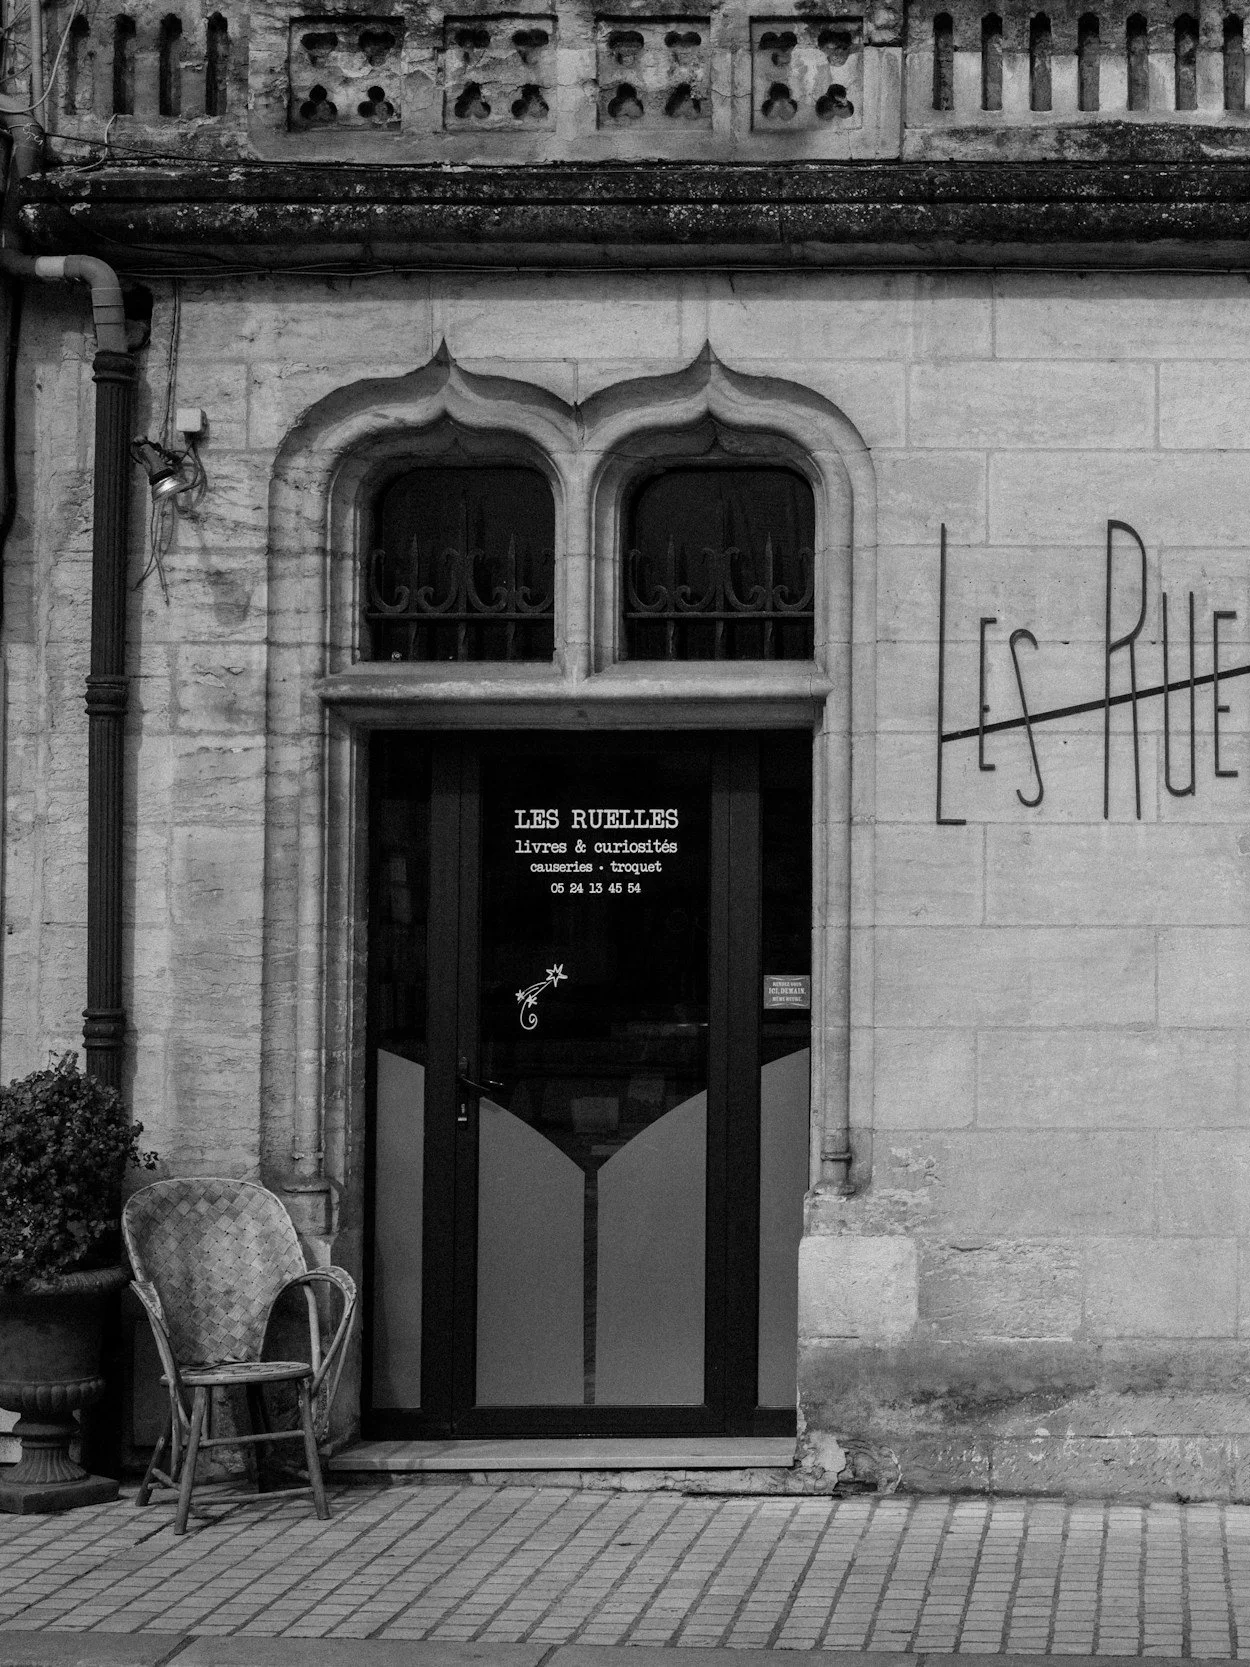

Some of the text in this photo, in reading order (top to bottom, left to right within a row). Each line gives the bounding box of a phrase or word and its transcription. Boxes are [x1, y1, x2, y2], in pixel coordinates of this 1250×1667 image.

[936, 522, 1044, 826] LES
[514, 808, 679, 829] LES RUELLES
[514, 838, 678, 854] livres & curiosités
[529, 860, 663, 876] causeries troquet
[550, 882, 642, 894] 05 24 13 45 54
